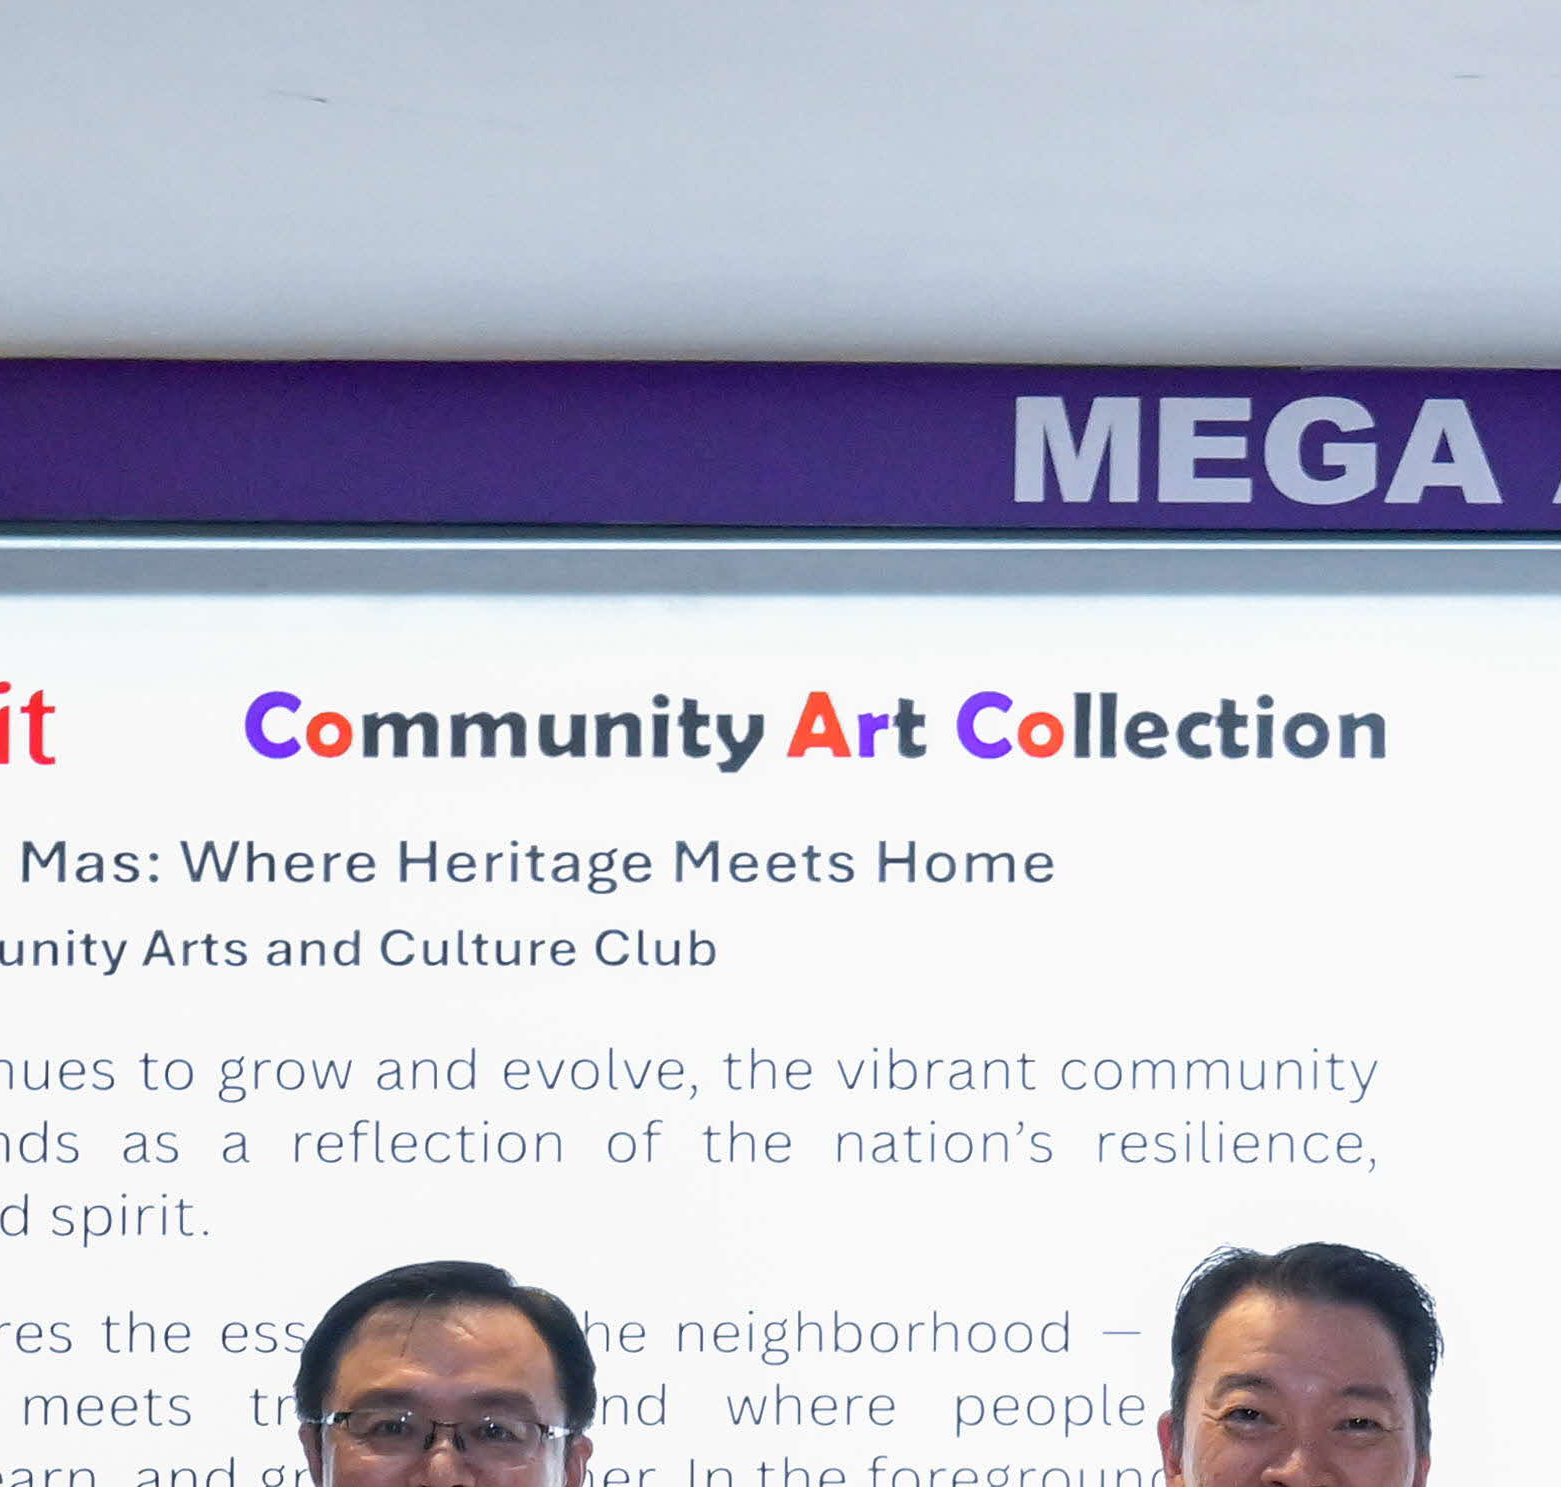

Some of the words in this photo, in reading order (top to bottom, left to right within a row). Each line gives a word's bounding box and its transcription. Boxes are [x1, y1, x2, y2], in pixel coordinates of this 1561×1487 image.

[1014, 396, 1502, 505] MEGA
[244, 690, 765, 774] Community
[786, 690, 928, 760] Art
[955, 690, 1387, 760] Collection
[21, 840, 159, 884] Mas:
[179, 840, 376, 884] Where
[399, 839, 653, 895] Heritage
[675, 839, 855, 884] Meets
[878, 840, 1055, 884] Home
[141, 929, 248, 967] Arts
[266, 928, 361, 967] and
[380, 928, 577, 967] Culture
[594, 928, 717, 967] Club
[138, 1052, 194, 1092] to
[217, 1055, 353, 1104] grow
[376, 1047, 476, 1092] and
[503, 1046, 698, 1101] evolve,
[722, 1047, 813, 1091] the
[836, 1047, 1037, 1091] vibrant
[1060, 1047, 1379, 1104] community
[122, 1131, 179, 1164] as
[222, 1131, 251, 1164] a
[294, 1118, 562, 1164] reflection
[607, 1119, 664, 1164] of
[702, 1119, 792, 1164] the
[837, 1119, 1053, 1164] nation’s
[1098, 1119, 1376, 1174] resilience,
[51, 1192, 209, 1249] spirit.
[100, 1309, 192, 1354] the
[678, 1309, 1070, 1367] neighborhood
[23, 1388, 193, 1428] meets
[726, 1382, 896, 1427] where
[955, 1383, 1146, 1439] people
